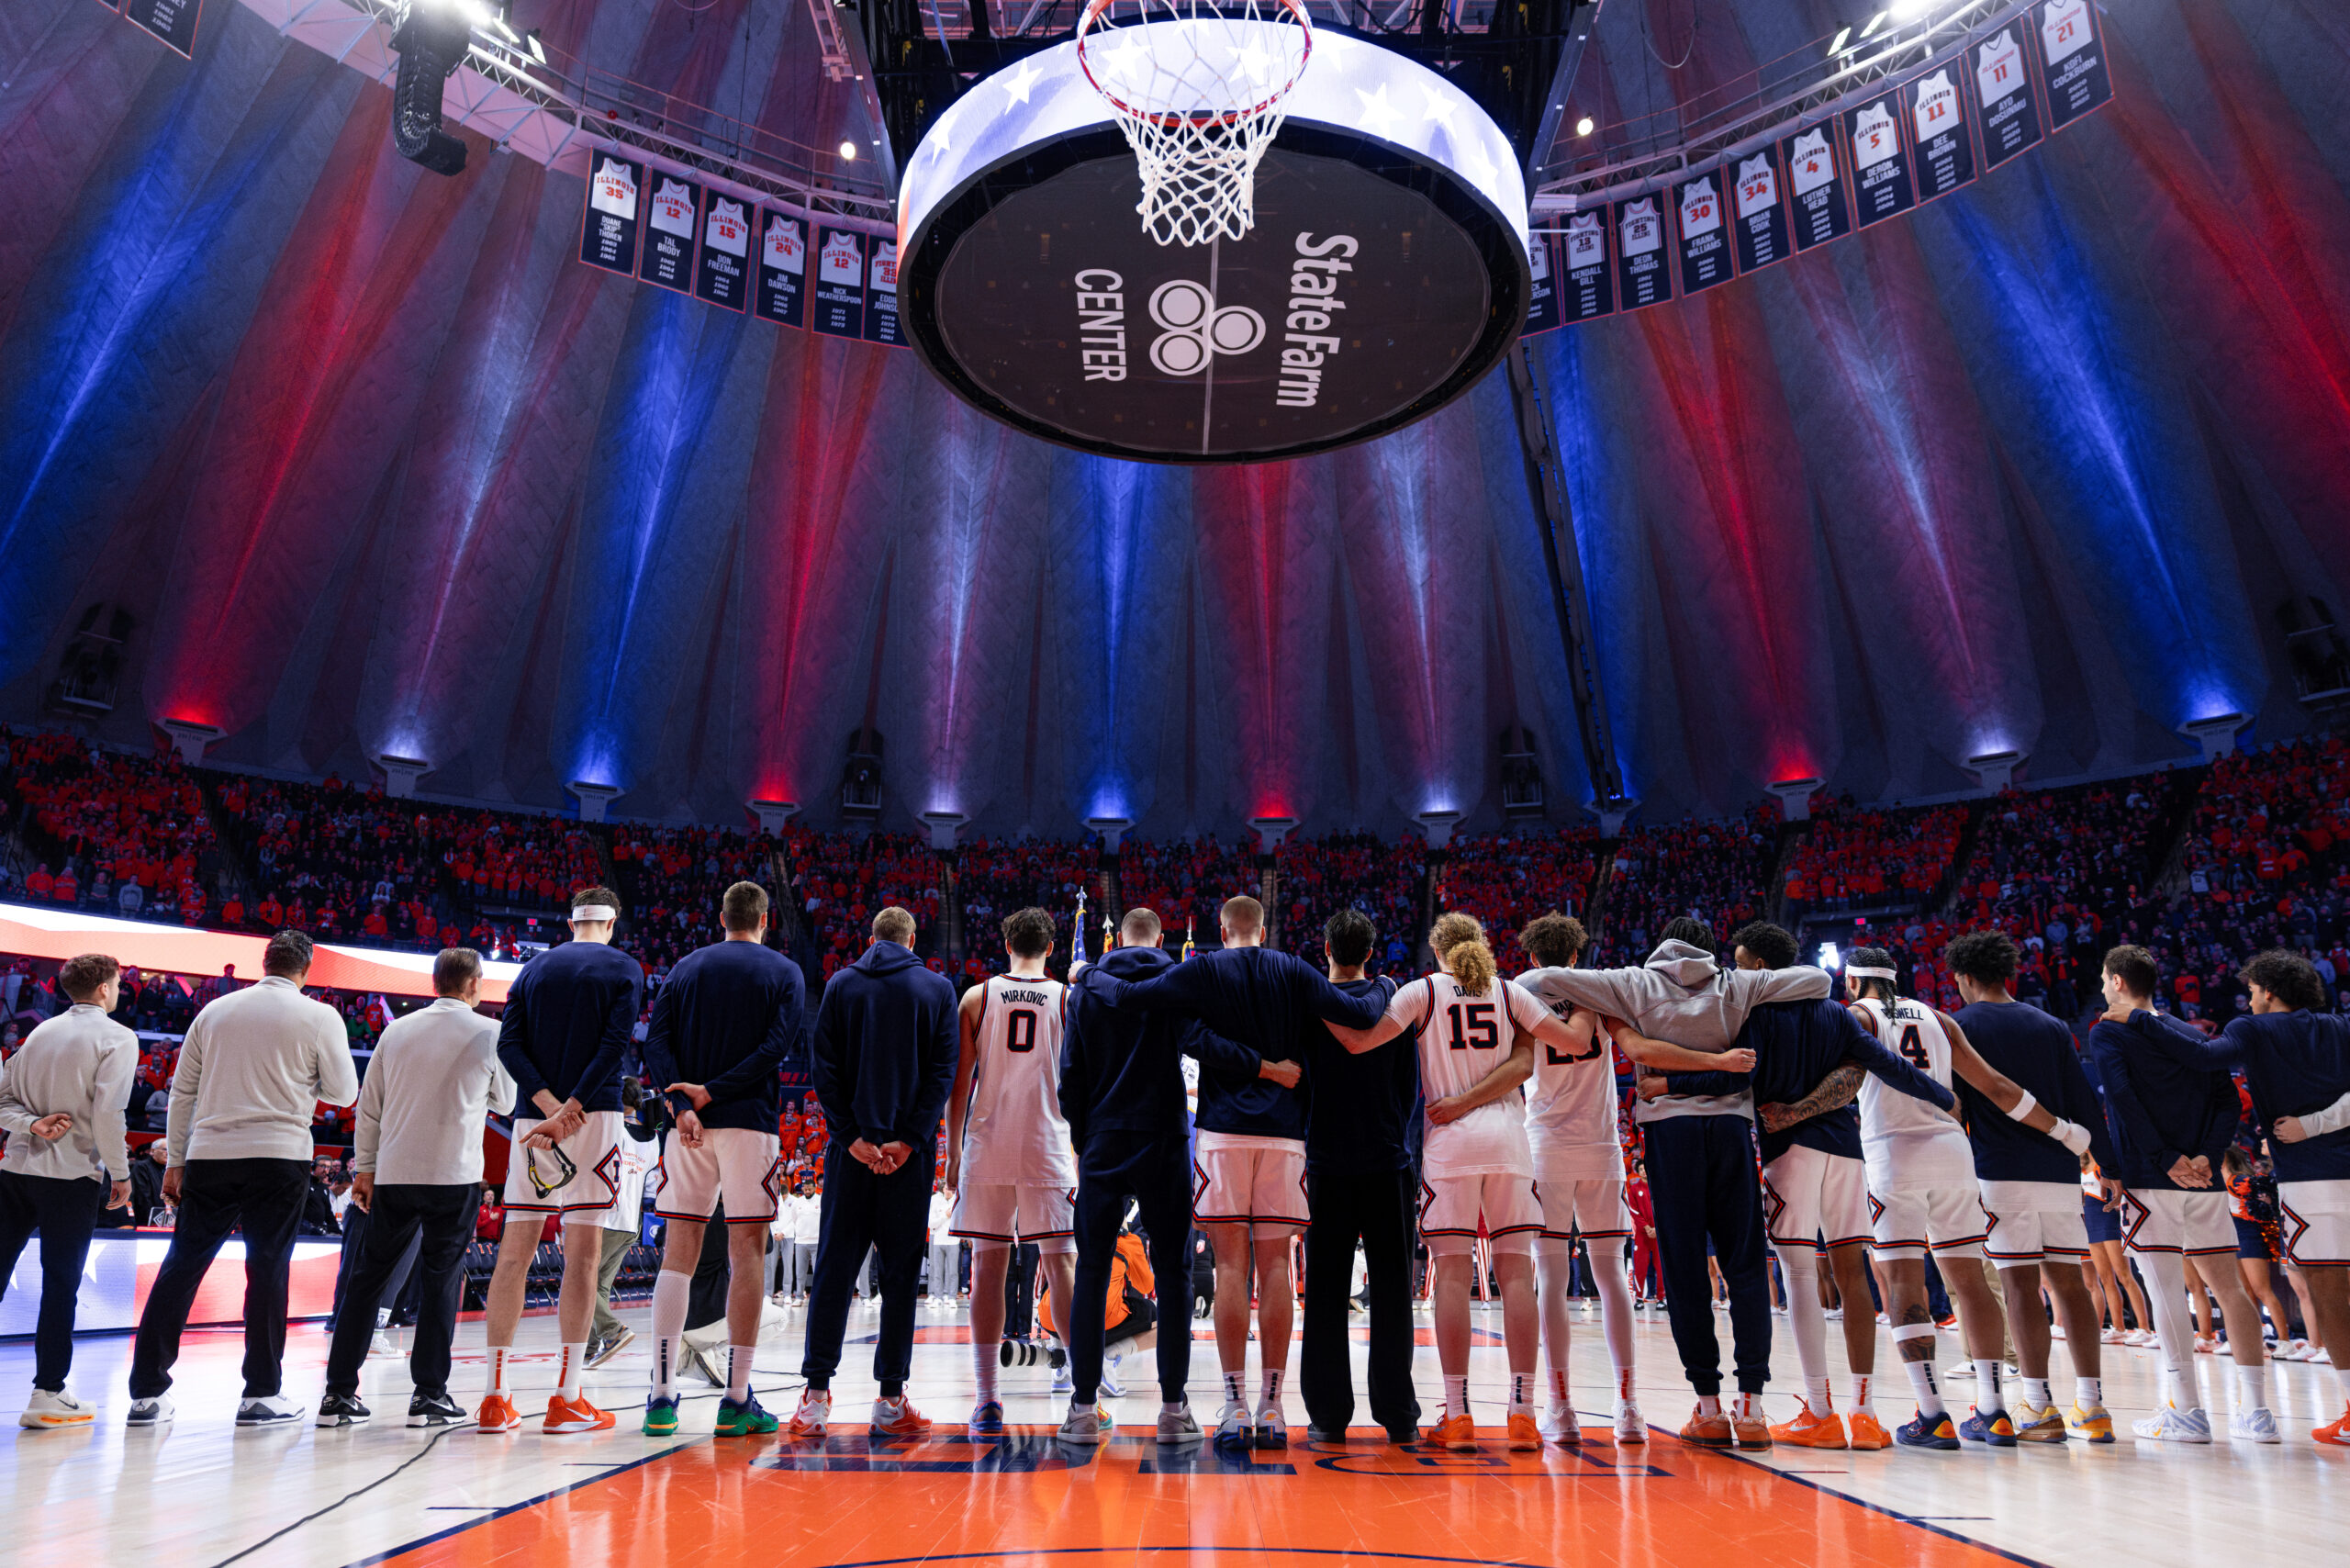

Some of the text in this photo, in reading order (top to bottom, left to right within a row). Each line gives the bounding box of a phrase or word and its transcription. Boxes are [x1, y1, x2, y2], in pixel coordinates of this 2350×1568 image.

[2057, 20, 2074, 43] 21
[2064, 53, 2082, 73] KOFI
[1994, 63, 2007, 83] 11
[2053, 56, 2097, 89] COCKBURN
[1919, 89, 1950, 110] ILLINOIS
[1999, 95, 2013, 112] AYO
[1928, 102, 1944, 121] 11
[1989, 97, 2027, 128] DOSUNMU
[1858, 120, 1889, 140] ILLINOIS
[1871, 133, 1880, 149] 5
[1933, 134, 1948, 148] DEE
[1796, 147, 1825, 165] ILLINOIS
[1928, 140, 1956, 161] BROWN
[1807, 160, 1818, 173] 4
[1867, 160, 1893, 178] DERON
[597, 176, 634, 195] ILLINOIS
[1740, 171, 1769, 188] ILLINOIS
[1862, 166, 1900, 189] WILLIAMS
[606, 185, 624, 199] 35
[1744, 182, 1767, 201] 34
[1803, 185, 1830, 204] LUTHER
[655, 196, 692, 215] ILLINOIS
[1684, 195, 1713, 211] ILLINOIS
[1808, 196, 1829, 211] HEAD
[666, 207, 680, 218] 12
[1690, 204, 1710, 222] 30
[1749, 209, 1770, 226] BRIAN
[602, 216, 622, 227] DUANE
[711, 215, 745, 233] ILLINOIS
[1625, 216, 1655, 230] FIGHTING
[1634, 223, 1647, 233] 25
[1751, 219, 1770, 234] COOK
[599, 229, 622, 242] THOREN
[720, 225, 736, 239] 15
[1571, 230, 1599, 243] FIGHTING
[1632, 230, 1651, 241] ILLINI
[1692, 232, 1716, 248] FRANK
[657, 242, 681, 257] BRODY
[665, 236, 676, 248] TAL
[767, 235, 801, 252] ILLINOIS
[776, 242, 792, 256] 24
[1576, 244, 1594, 253] ILLINI
[1687, 239, 1722, 259] WILLIAMS
[718, 254, 732, 264] DON
[824, 250, 859, 264] ILLINOIS
[834, 257, 849, 268] 12
[1634, 253, 1652, 265] DEON
[708, 259, 740, 276] FREEMAN
[1572, 265, 1603, 281] KENDALL
[1629, 260, 1659, 275] THOMAS
[767, 279, 796, 294] DAWSON
[777, 274, 788, 283] JIM
[1580, 275, 1595, 286] GILL
[834, 286, 846, 296] NICK
[1532, 282, 1541, 292] CK
[817, 290, 862, 305] WEATHERSPOON
[879, 294, 896, 303] EDDI
[1075, 269, 1126, 382] CENTER
[1001, 990, 1047, 1007] MIRKOVIC
[1550, 999, 1574, 1015] WAG
[1881, 1008, 1924, 1021] BSWELL
[1007, 1009, 1037, 1053] 0
[1448, 1003, 1498, 1050] 15
[1899, 1024, 1930, 1070] 4
